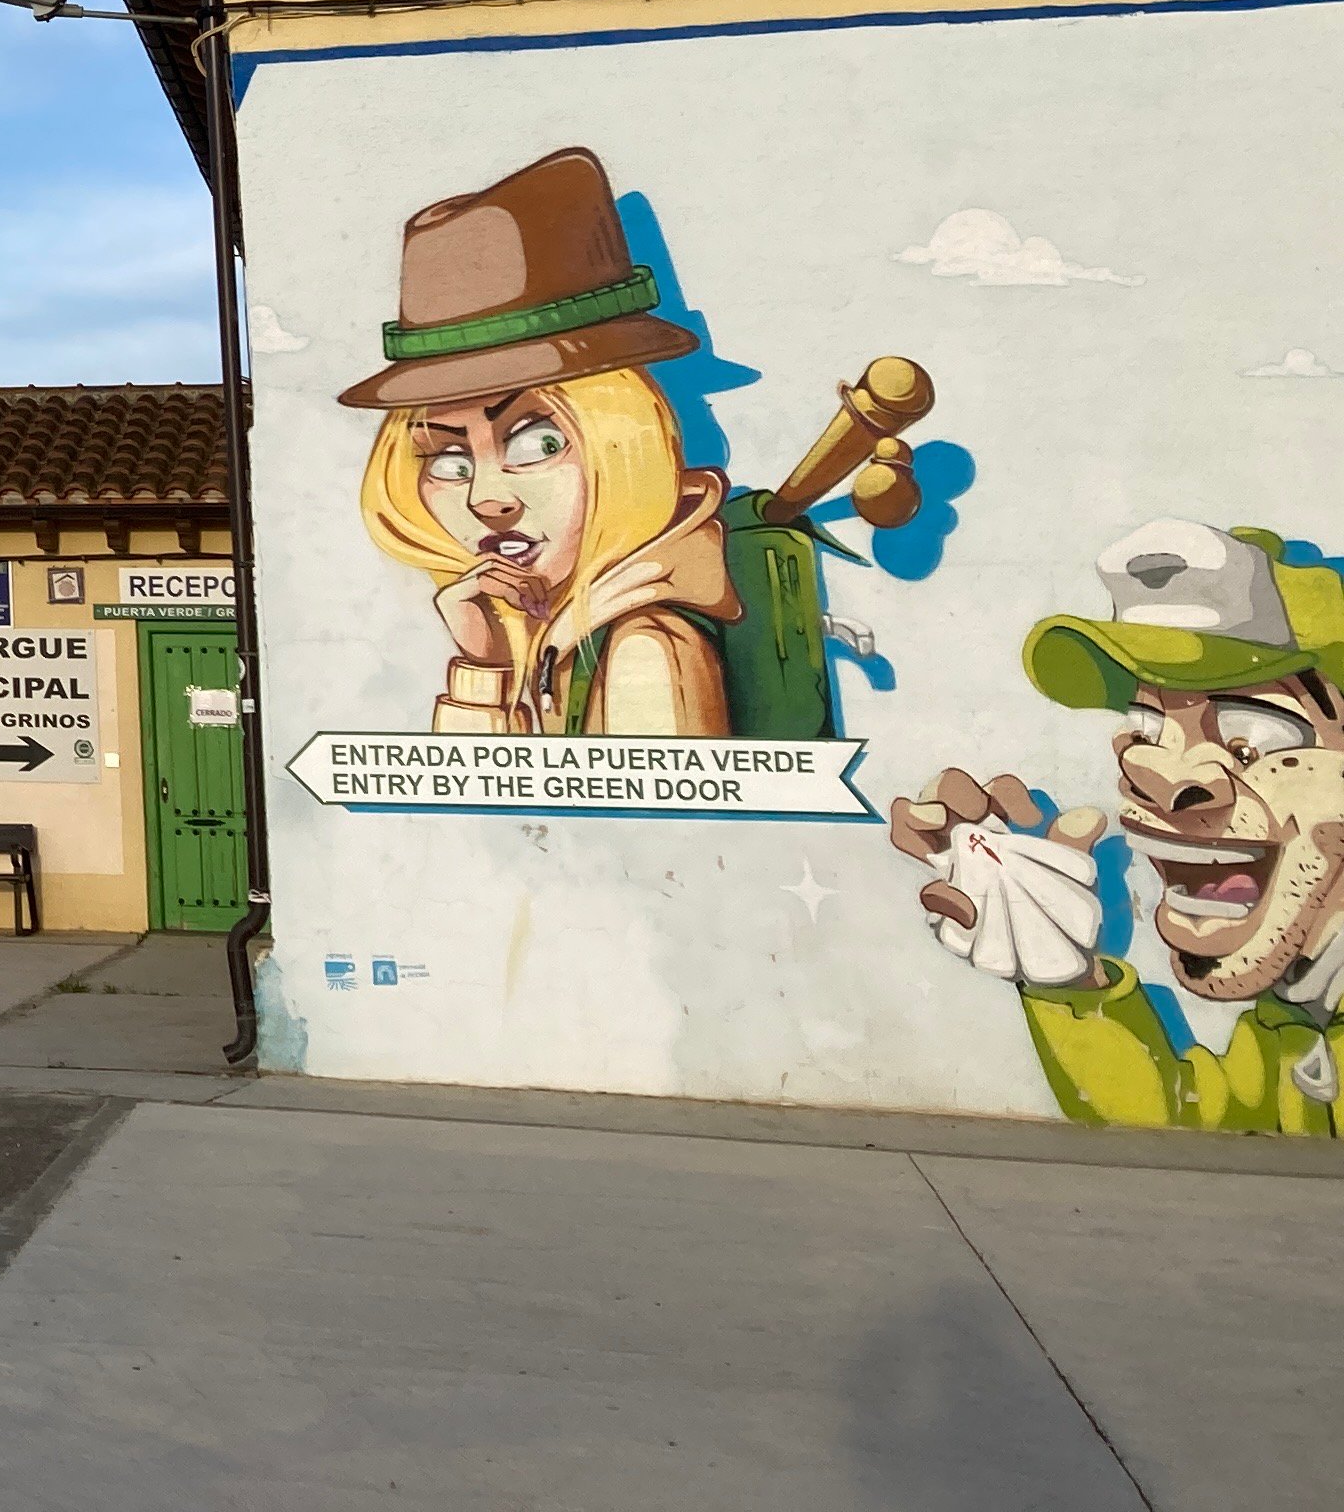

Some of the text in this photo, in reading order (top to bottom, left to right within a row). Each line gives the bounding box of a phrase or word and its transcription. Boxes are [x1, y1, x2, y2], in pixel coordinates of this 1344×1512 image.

[129, 575, 236, 598] RECEPC
[104, 607, 155, 617] PUERTA
[158, 607, 203, 618] VERDE
[216, 608, 235, 618] GR
[195, 708, 233, 717] CERRADO
[331, 745, 815, 774] ENTRADA POR LA PUERTA VERDE
[332, 773, 743, 803] ENTRY BY THE GREEN DOOR
